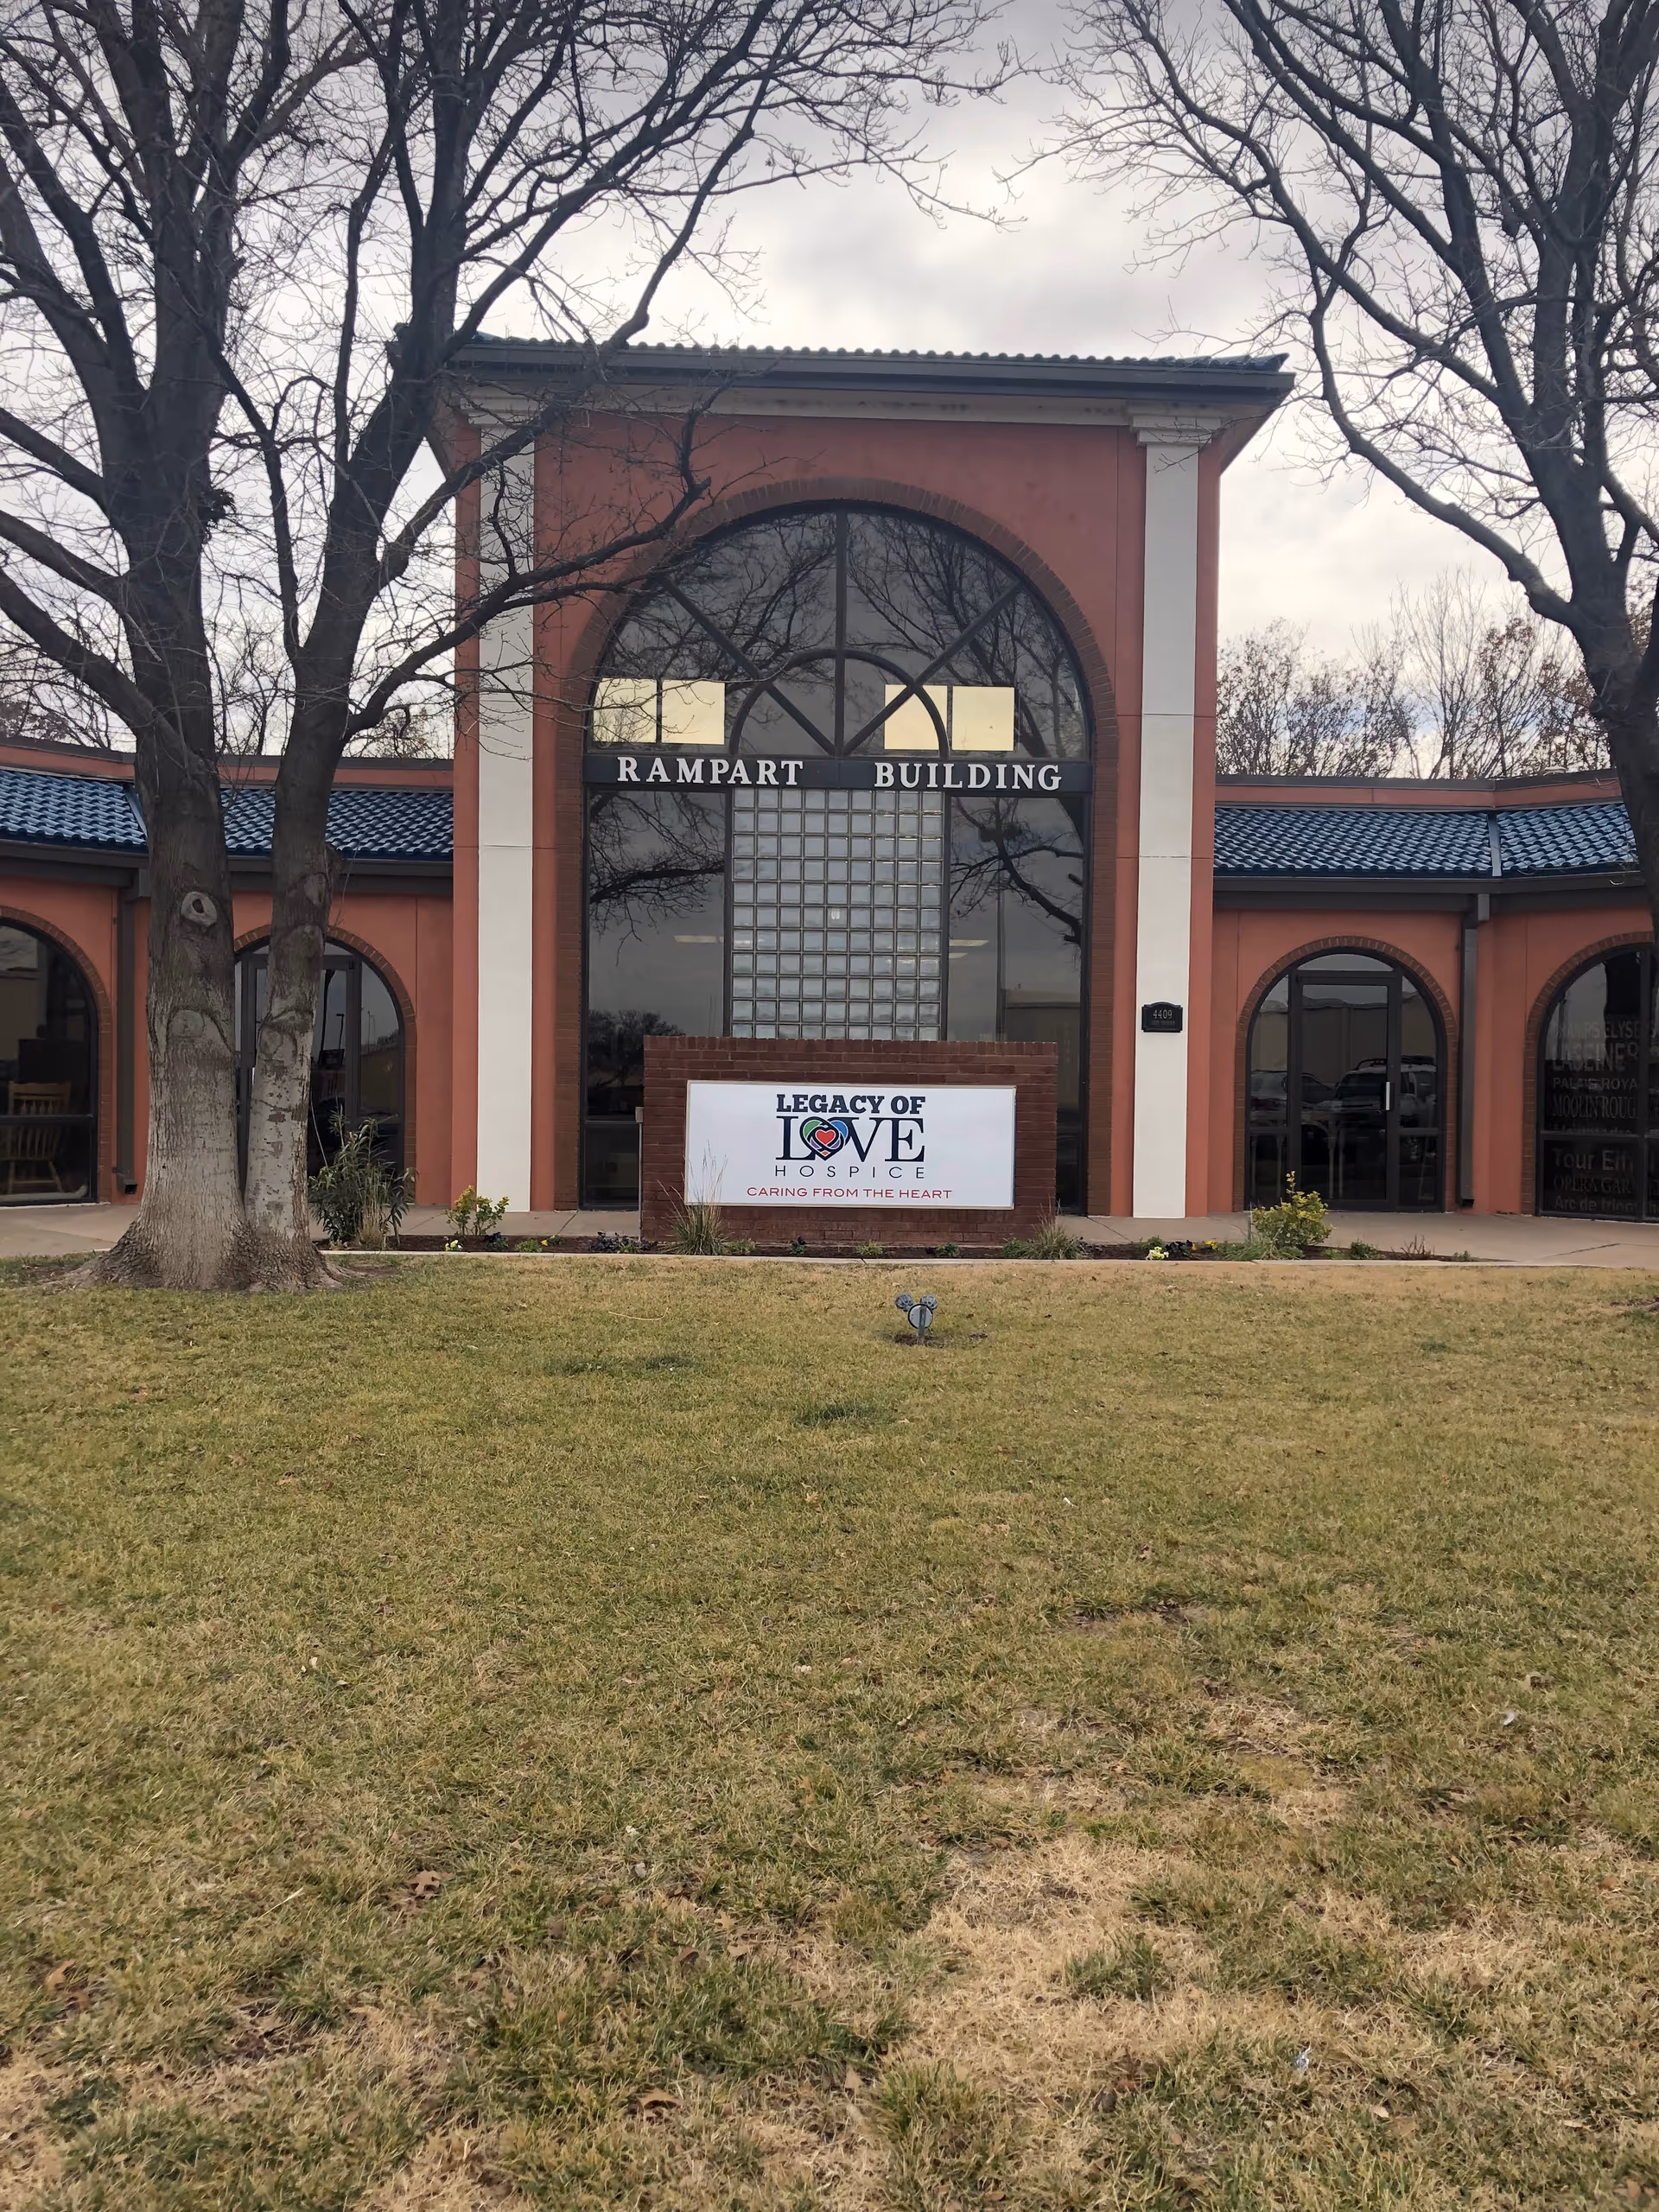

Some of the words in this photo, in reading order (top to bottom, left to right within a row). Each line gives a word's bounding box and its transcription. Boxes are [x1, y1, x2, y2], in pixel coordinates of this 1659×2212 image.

[617, 756, 804, 786] RAMPART
[874, 762, 1062, 791] BUILDING
[1153, 1009, 1173, 1020] 4409
[776, 1094, 885, 1114] LEGACY
[891, 1095, 925, 1115] OF
[776, 1116, 925, 1162] LOVE
[775, 1166, 925, 1179] HOSPICE
[747, 1187, 807, 1198] CARING
[813, 1188, 858, 1198] FROM
[863, 1189, 894, 1198] THE
[899, 1189, 952, 1199] HEART
